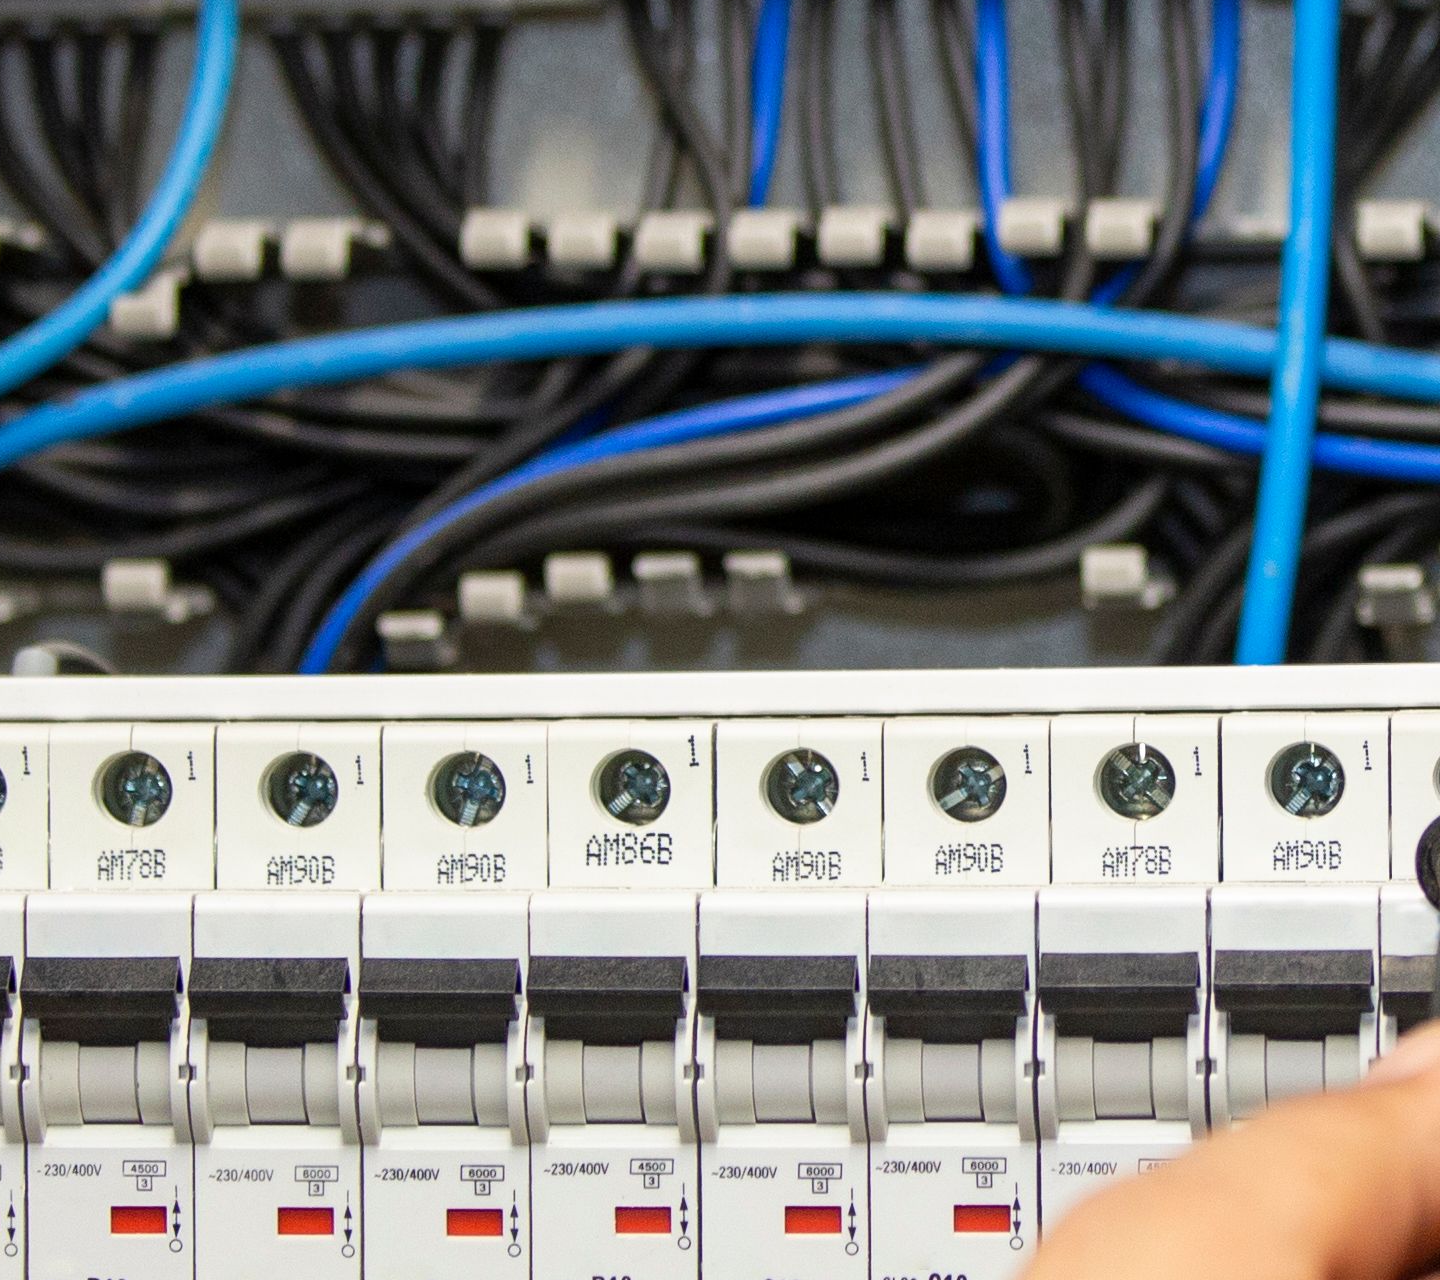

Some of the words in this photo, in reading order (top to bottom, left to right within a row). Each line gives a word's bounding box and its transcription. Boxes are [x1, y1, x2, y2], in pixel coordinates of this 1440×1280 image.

[22, 746, 30, 775] 1
[187, 751, 196, 781] 1
[688, 735, 699, 767] 1
[1023, 744, 1032, 774] 1
[1193, 746, 1202, 776] 1
[1363, 741, 1372, 770] 1
[355, 755, 364, 785] 1
[525, 755, 534, 784] 1
[861, 752, 869, 782] 1
[98, 849, 165, 880] AM78B
[586, 833, 672, 866] AM86B
[936, 843, 1003, 874] AM90B
[1102, 845, 1171, 877] AM78B
[1273, 840, 1341, 870] AM90B
[267, 855, 334, 885] AM90B
[438, 853, 505, 884] AM90B
[773, 851, 841, 881] AM90B
[129, 1164, 161, 1174] 4500
[636, 1161, 668, 1172] 4500
[969, 1160, 1001, 1171] 6000
